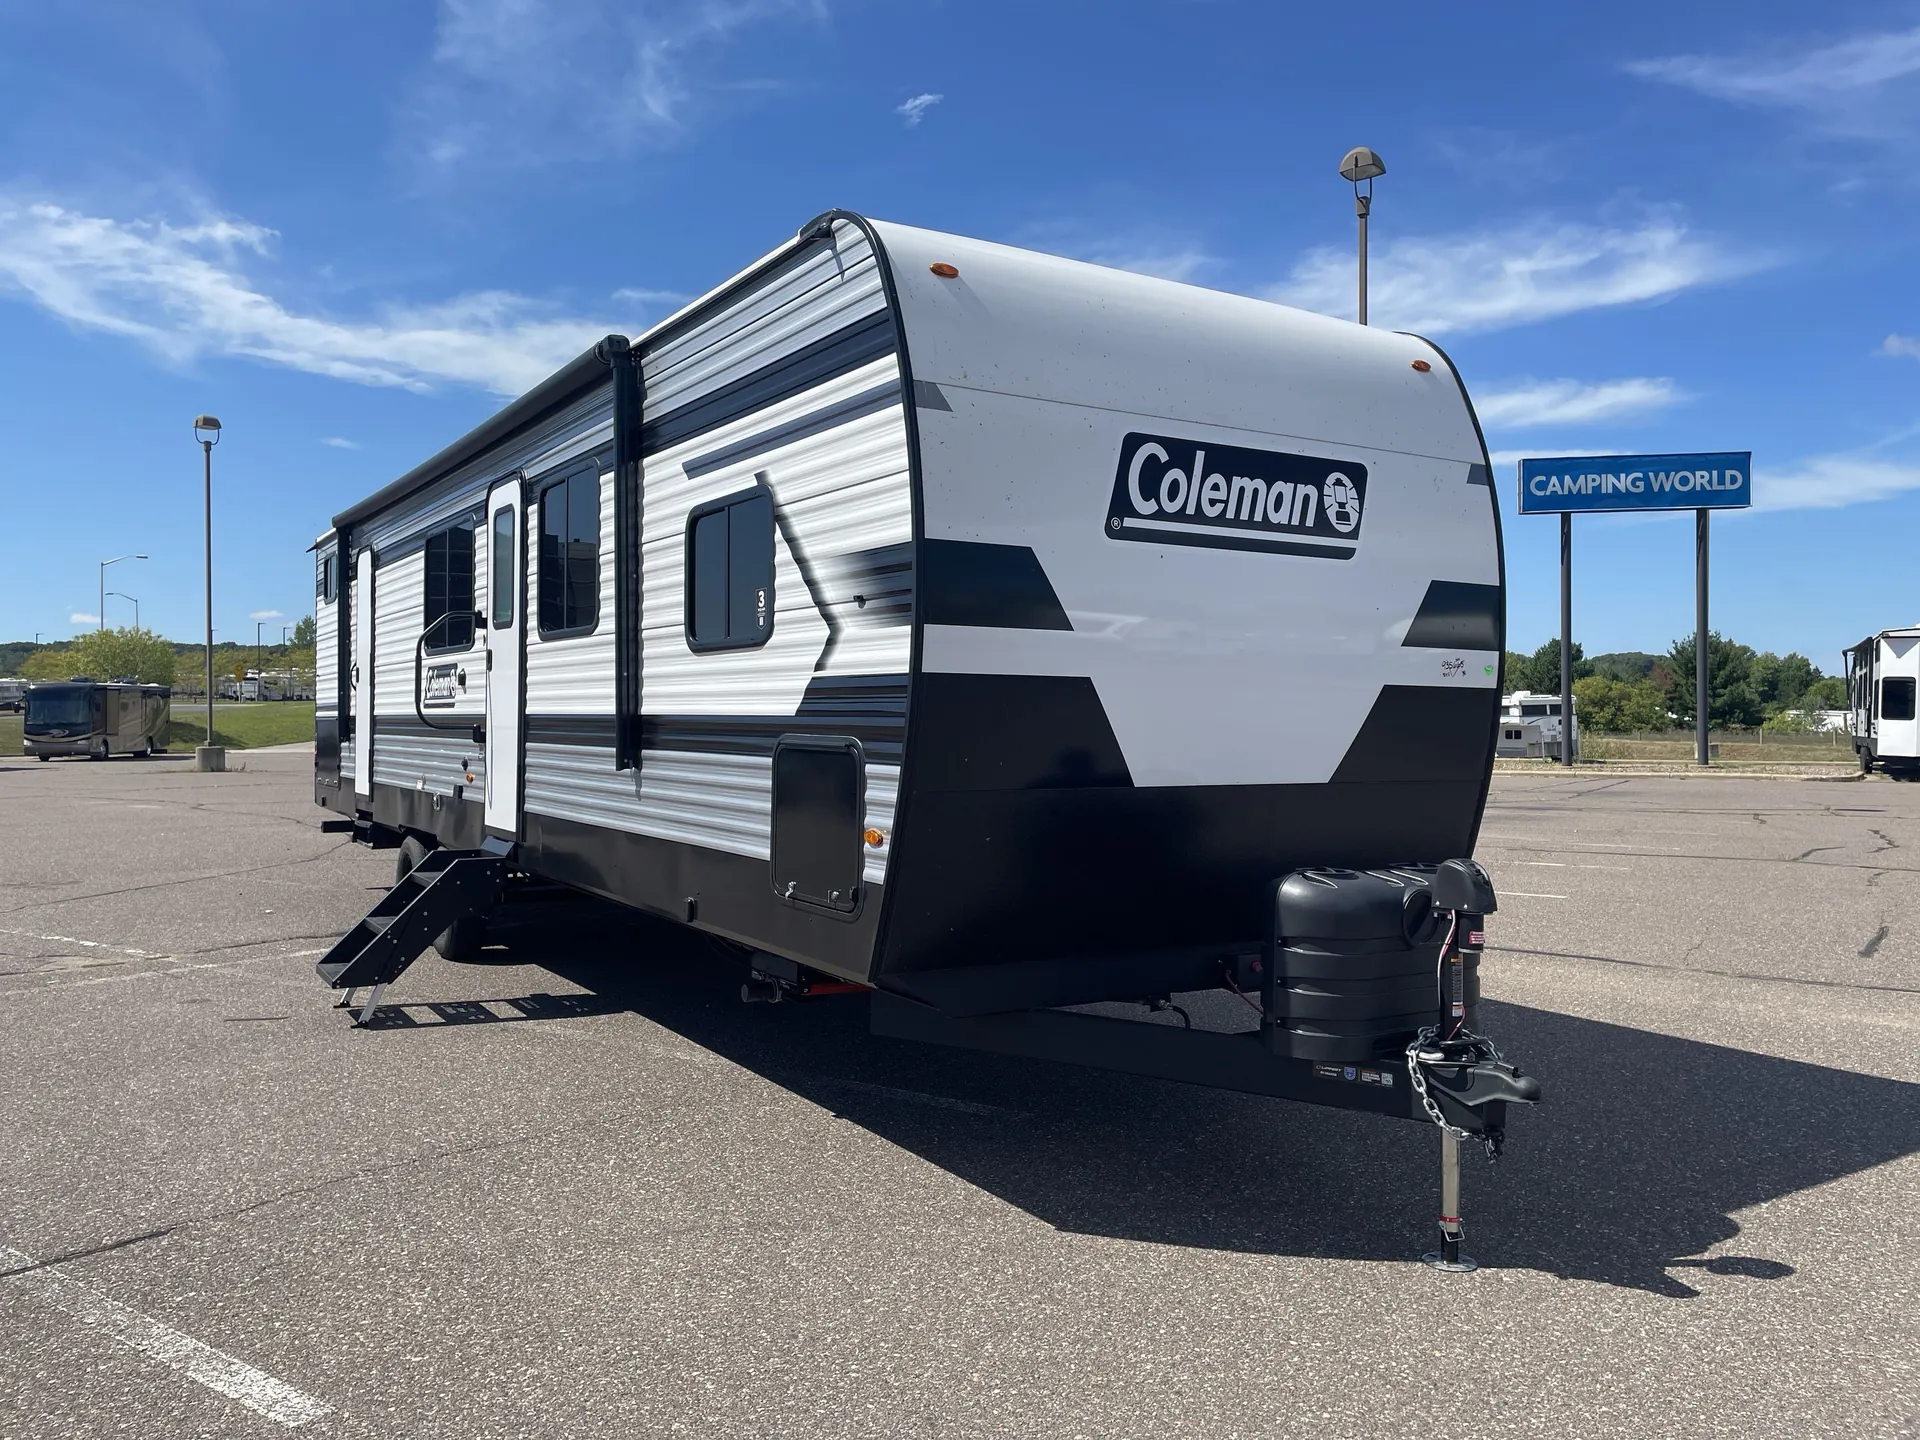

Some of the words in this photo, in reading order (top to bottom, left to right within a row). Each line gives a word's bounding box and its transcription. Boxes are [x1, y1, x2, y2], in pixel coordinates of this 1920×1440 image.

[1128, 442, 1319, 528] Coleman
[1529, 472, 1645, 496] CAMPING
[1648, 469, 1743, 493] WORLD
[758, 591, 765, 607] 3
[426, 669, 450, 698] Coleman
